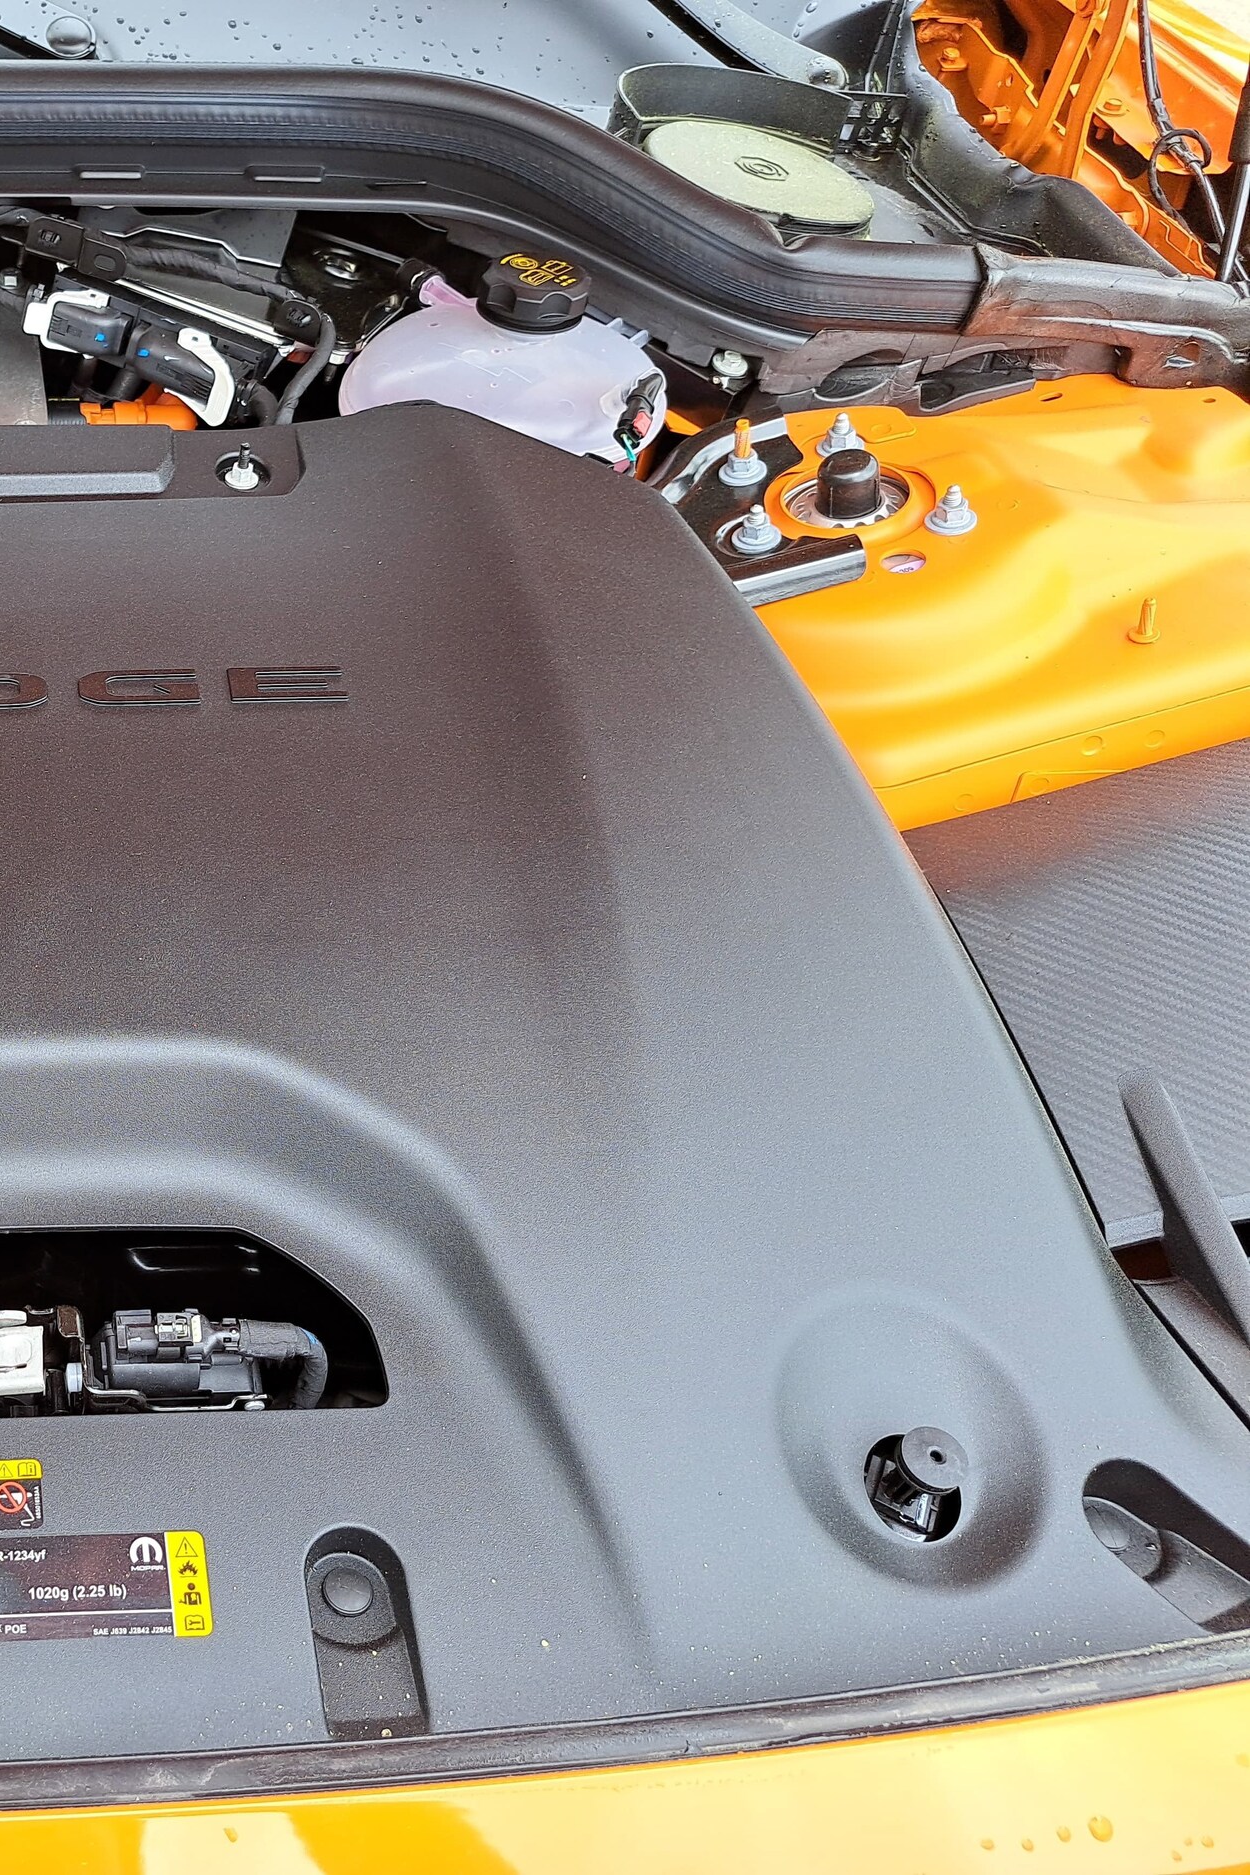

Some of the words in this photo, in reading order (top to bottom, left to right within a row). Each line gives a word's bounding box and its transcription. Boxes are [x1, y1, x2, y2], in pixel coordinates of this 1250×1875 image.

[28, 1586, 70, 1602] 1020g
[72, 1584, 106, 1601] (2.25
[109, 1583, 127, 1600] lb)
[4, 1624, 27, 1635] POE
[93, 1628, 109, 1636] SAE
